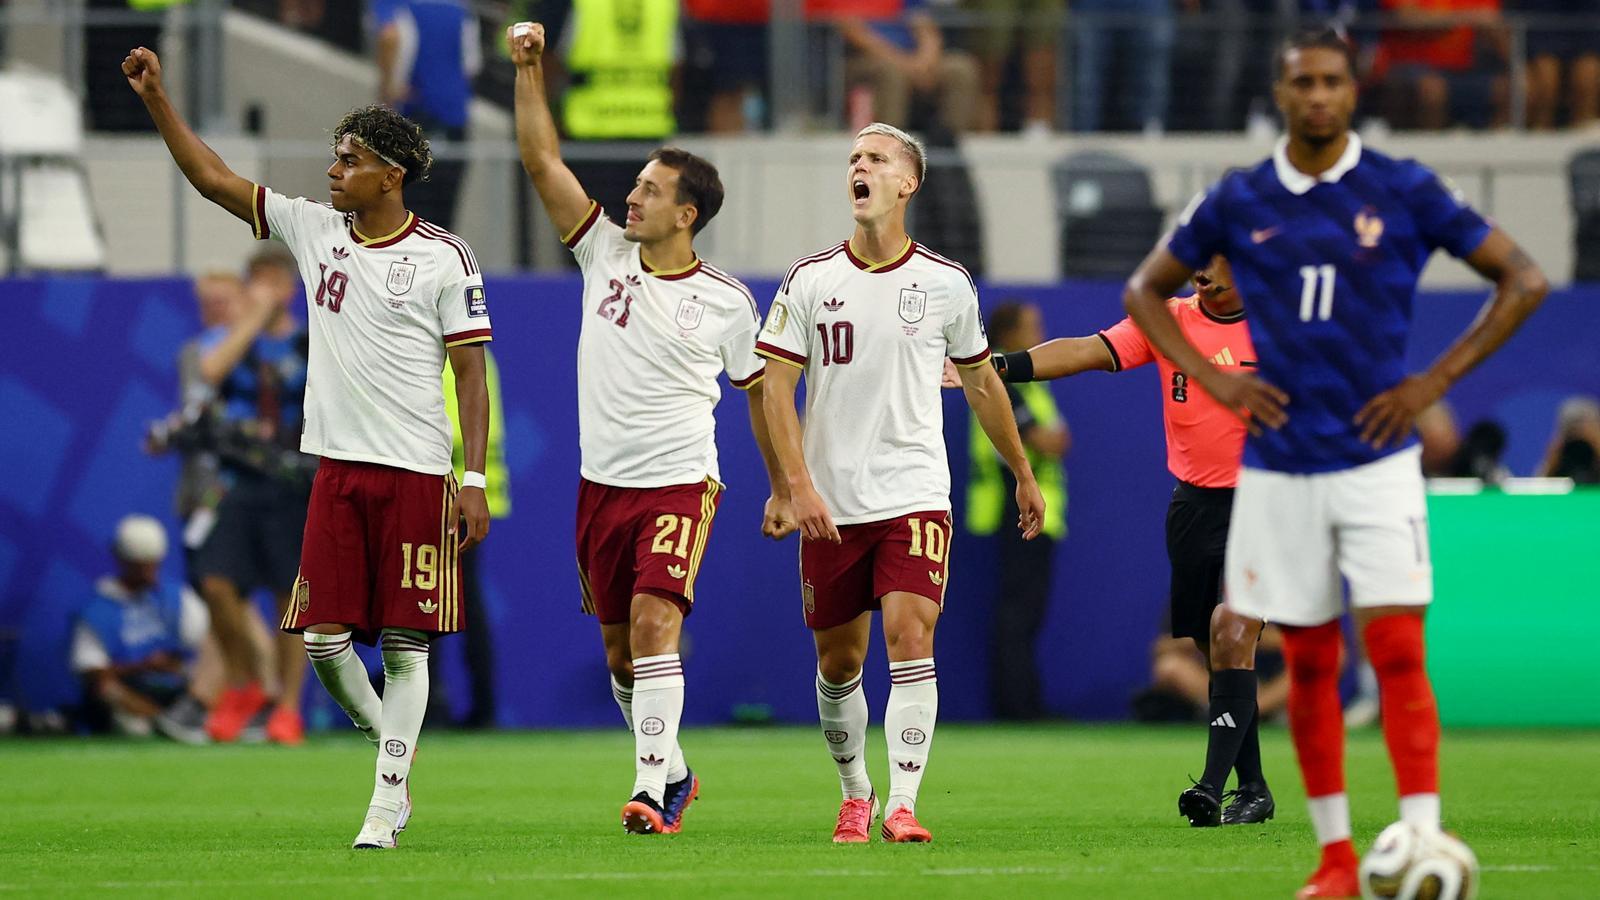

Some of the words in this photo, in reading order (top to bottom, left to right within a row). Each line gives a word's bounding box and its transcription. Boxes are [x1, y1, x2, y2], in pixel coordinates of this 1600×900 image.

[315, 262, 348, 314] 19
[597, 278, 632, 328] 21
[1299, 264, 1336, 322] 11
[816, 321, 854, 366] 10
[651, 514, 692, 559] 21
[907, 518, 944, 563] 10
[401, 543, 438, 590] 19
